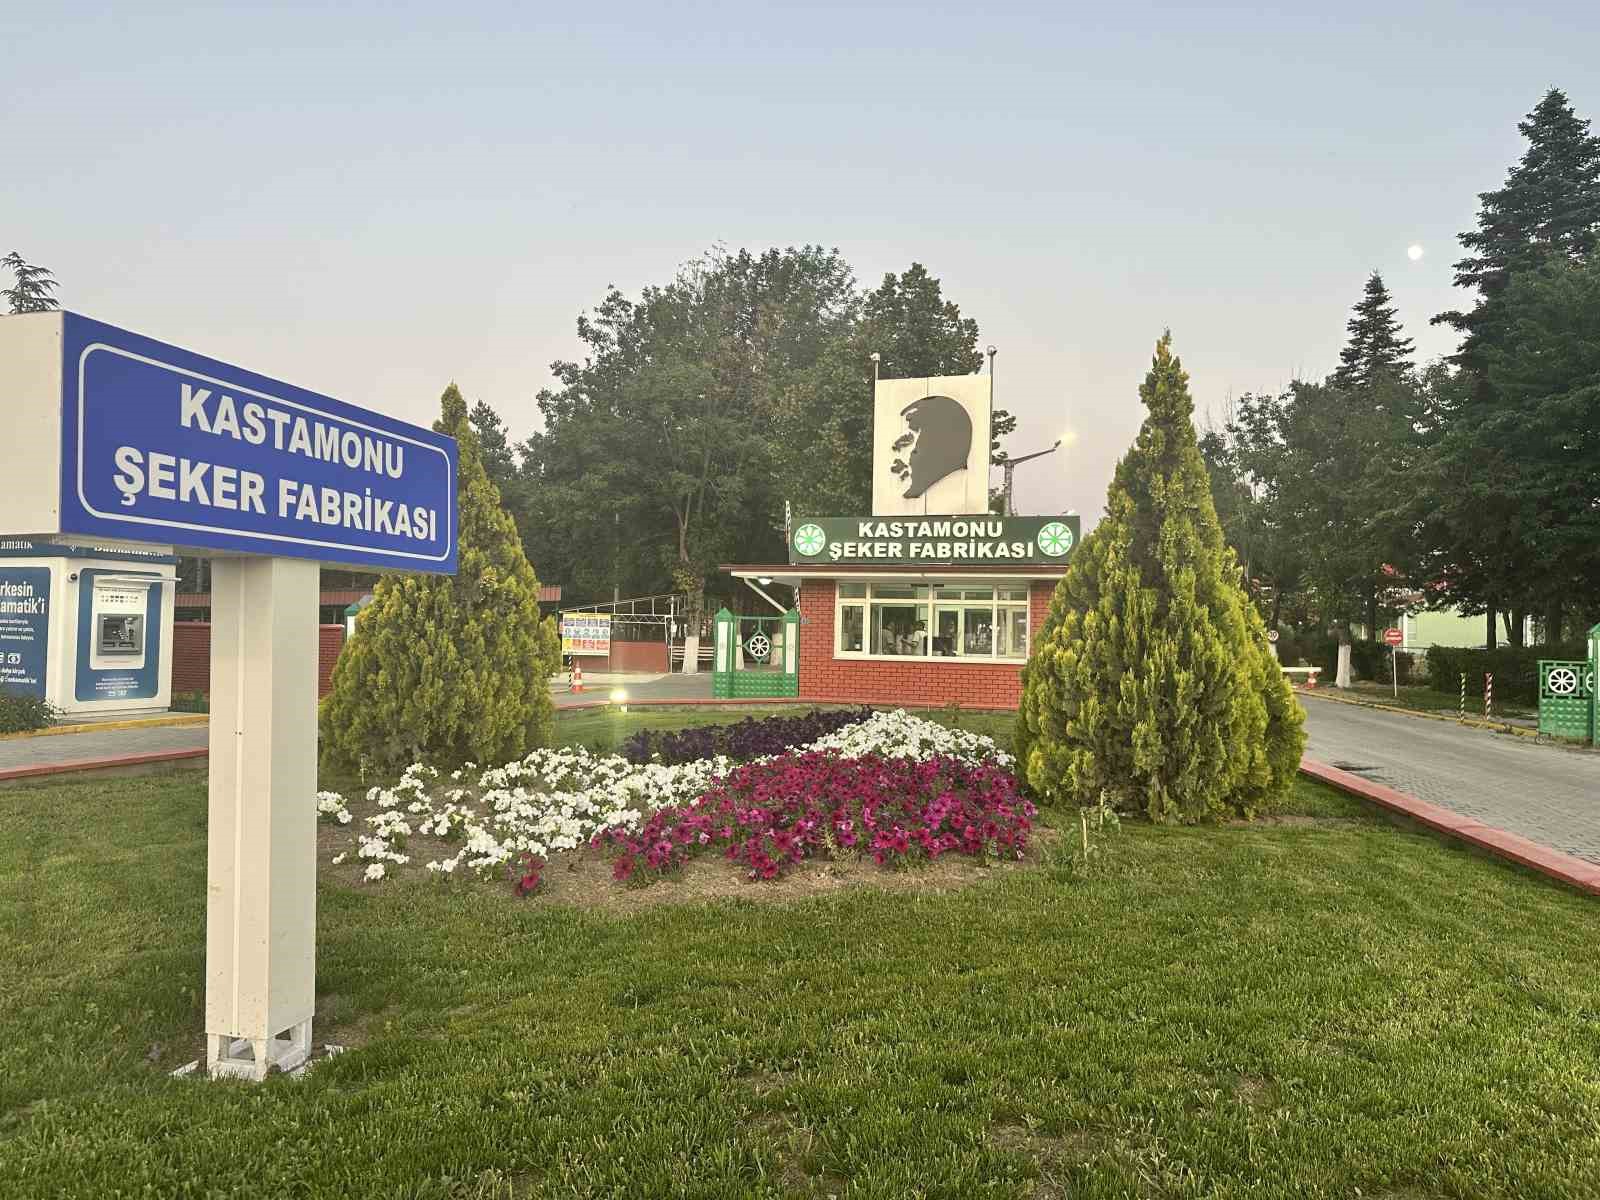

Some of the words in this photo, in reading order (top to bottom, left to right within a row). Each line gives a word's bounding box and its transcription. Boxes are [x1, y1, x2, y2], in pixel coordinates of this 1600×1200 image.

[180, 383, 404, 478] KASTAMONU
[113, 446, 266, 515] ŞEKER
[278, 479, 437, 542] FABRİKASI
[829, 541, 902, 561] ŞEKER
[907, 538, 1034, 559] FABRİKASI
[858, 521, 1003, 538] KASTAMONU
